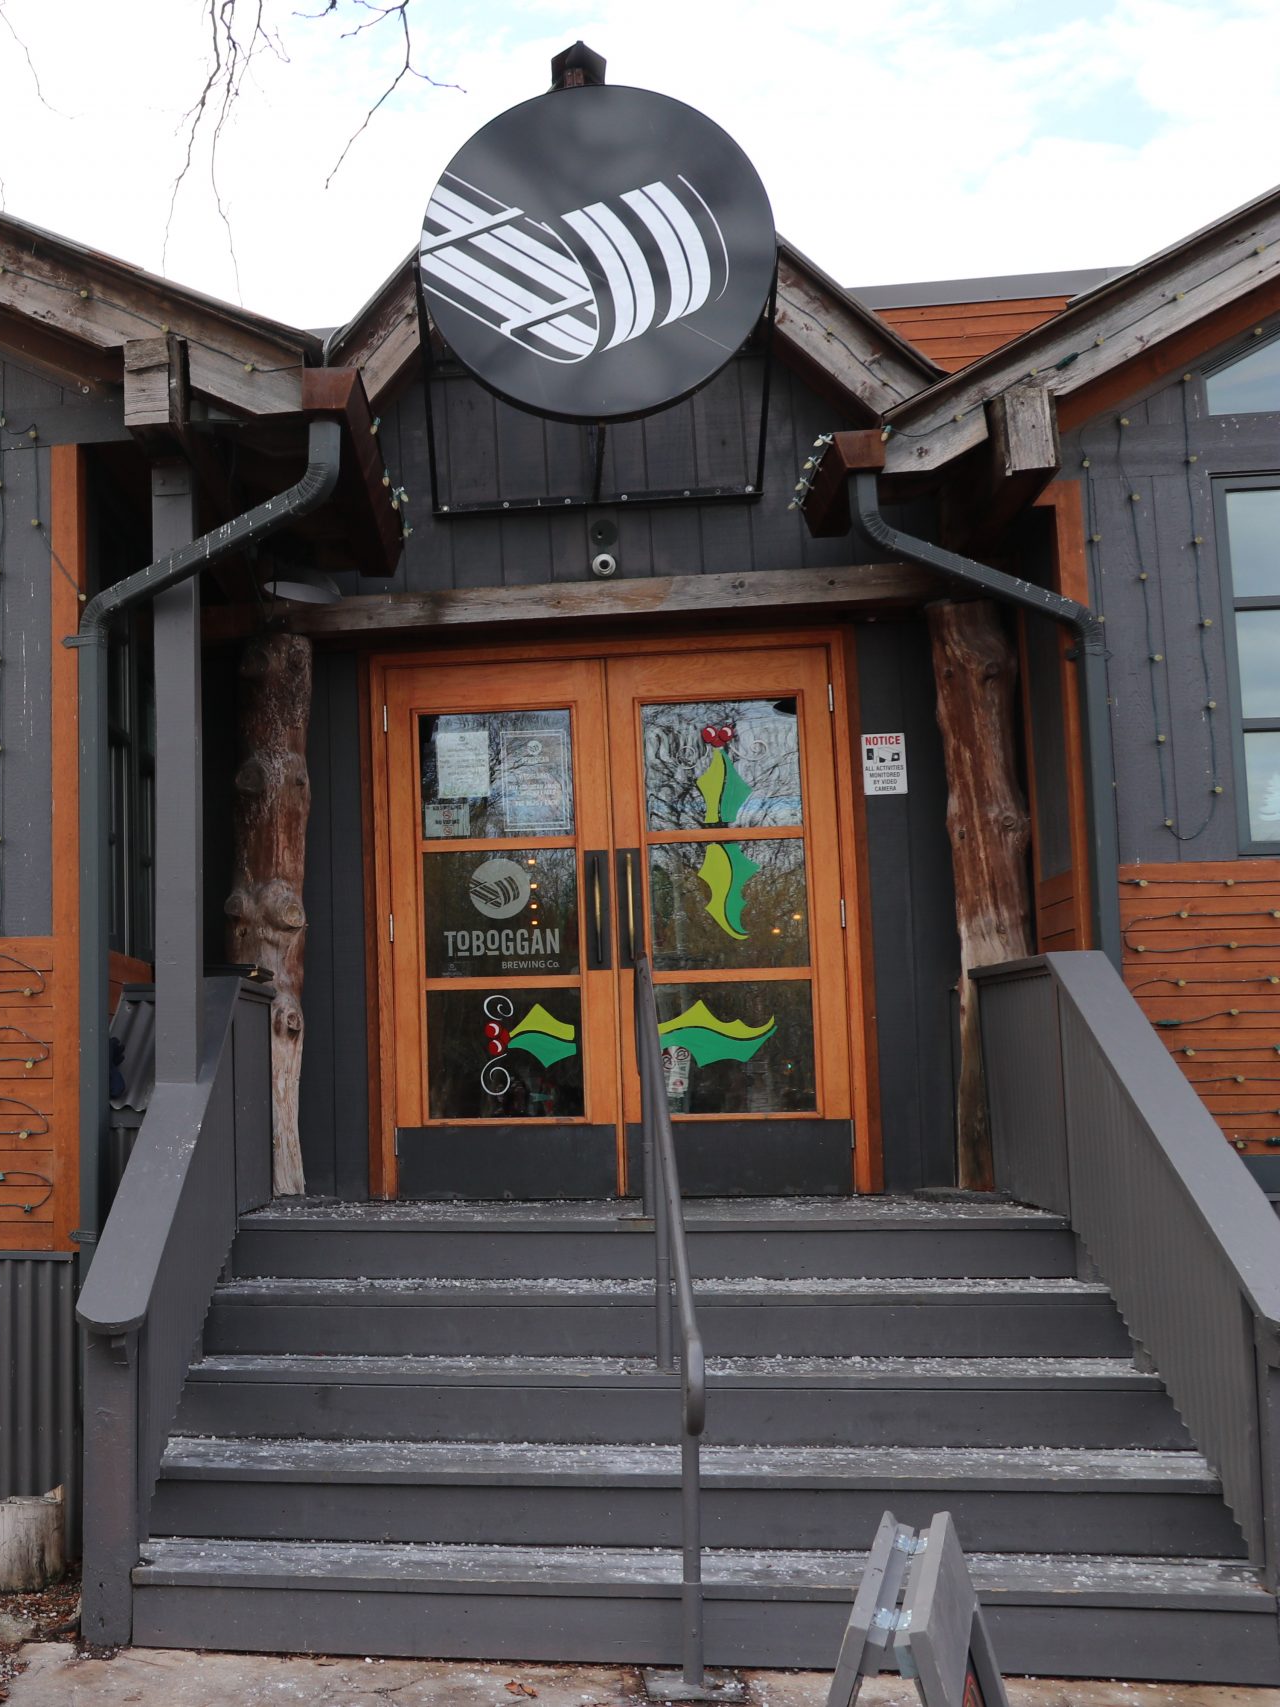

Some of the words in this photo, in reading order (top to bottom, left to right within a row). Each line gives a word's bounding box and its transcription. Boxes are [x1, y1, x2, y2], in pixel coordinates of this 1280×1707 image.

[865, 735, 901, 746] NOTICE
[443, 928, 560, 957] TOBOGGAN
[501, 960, 546, 969] BREWING
